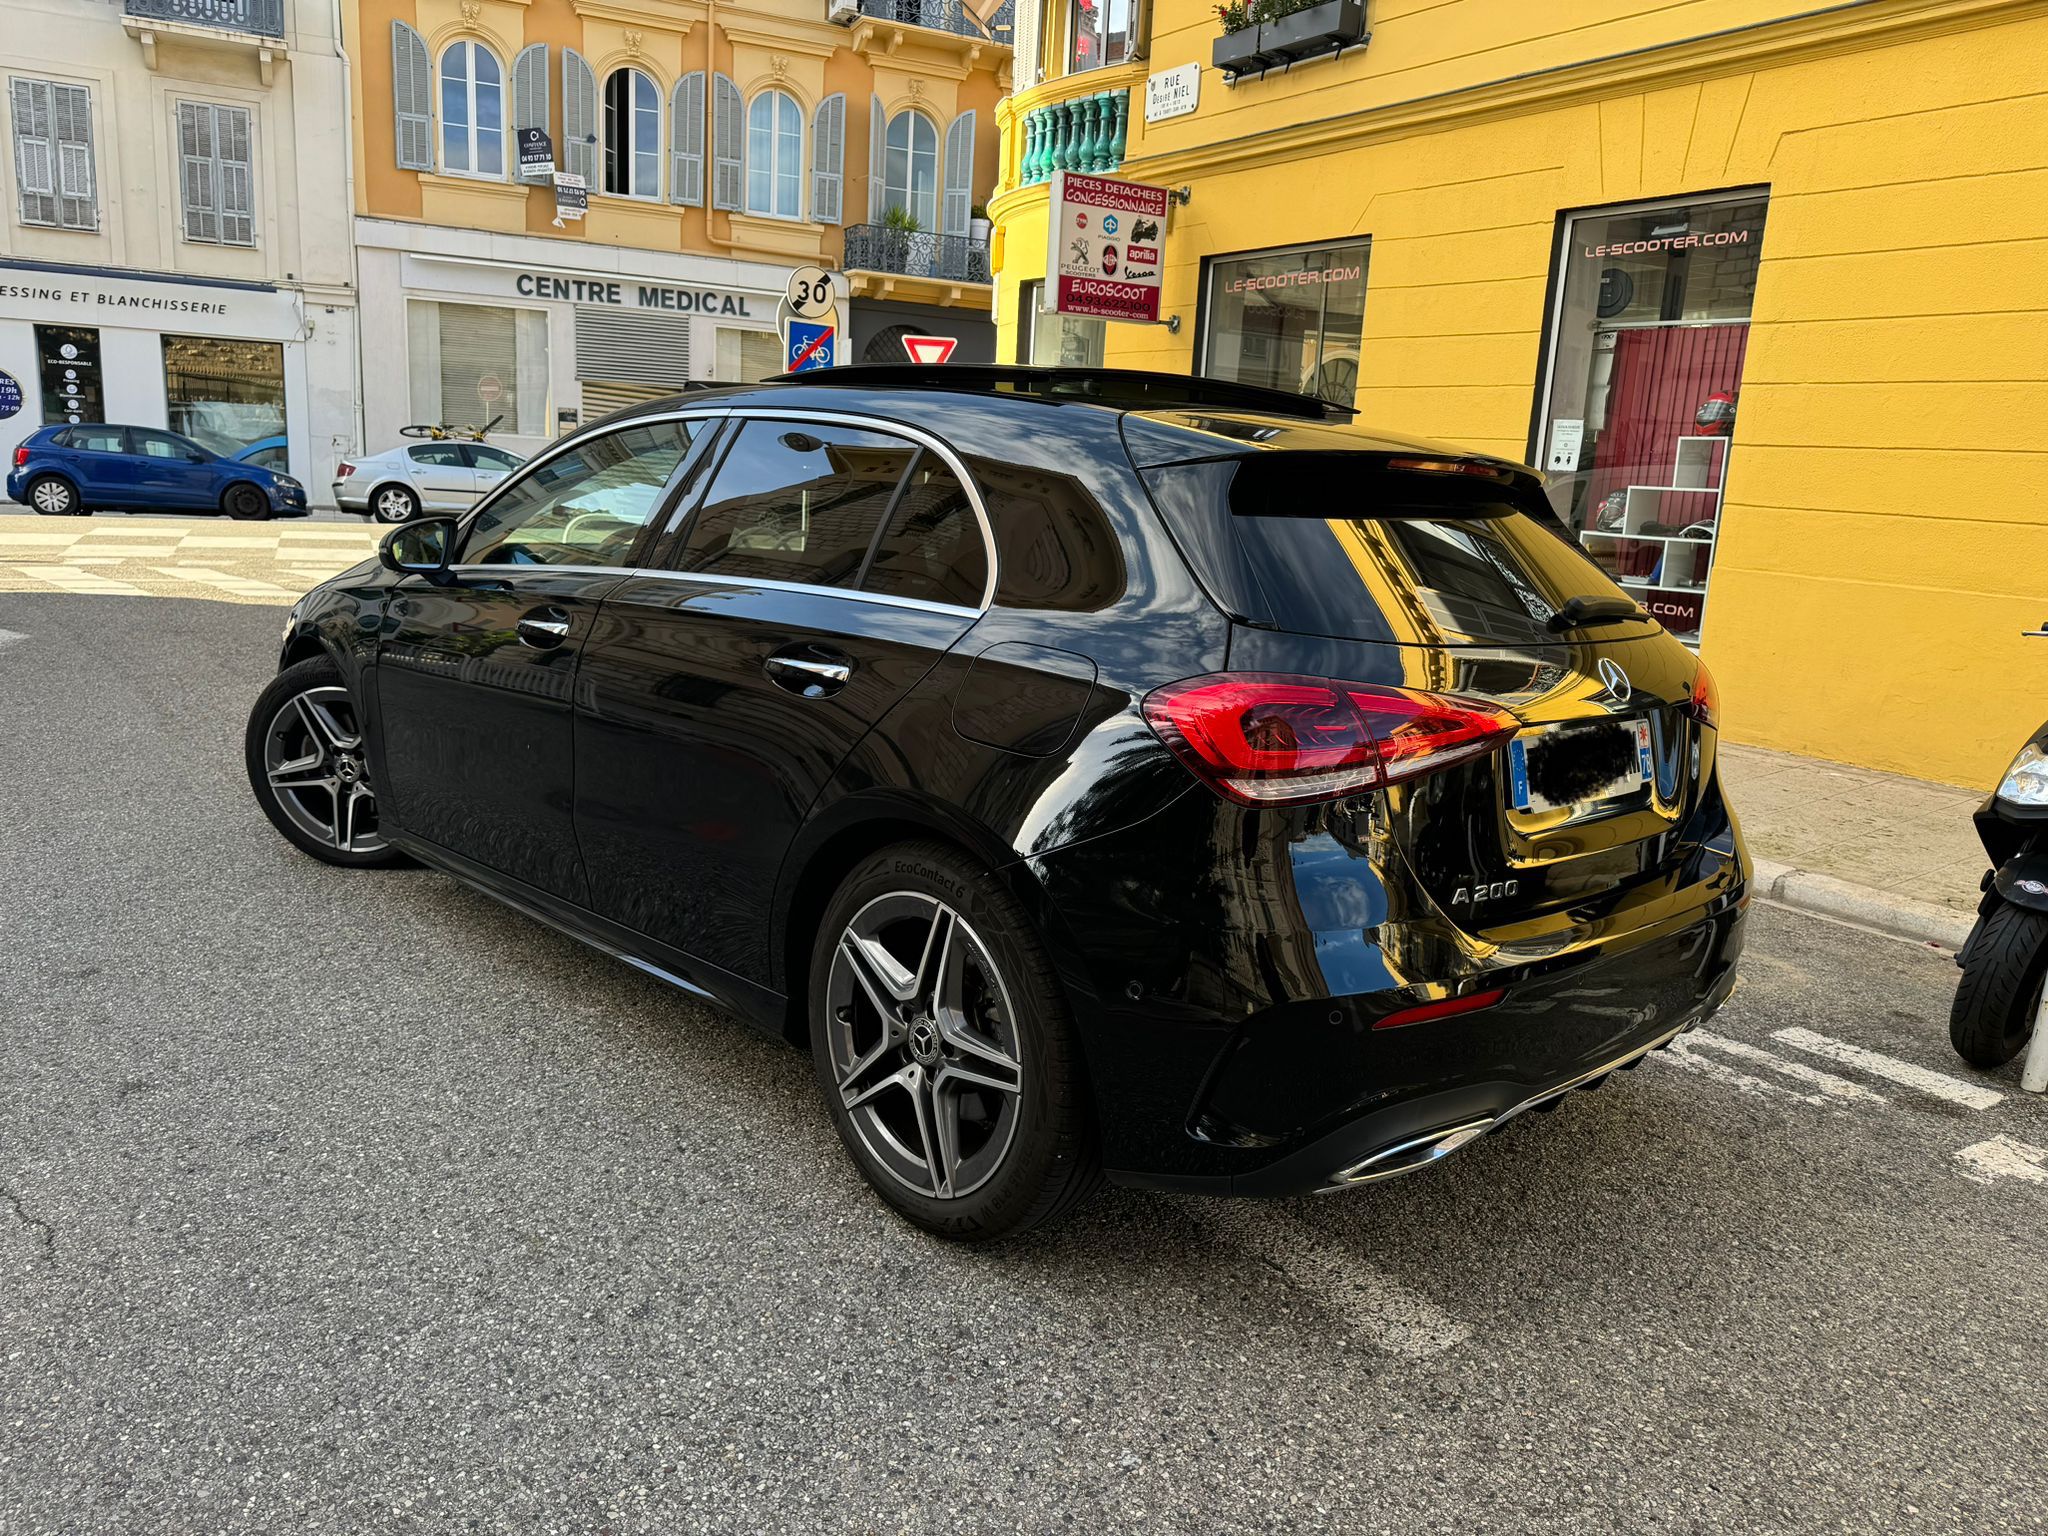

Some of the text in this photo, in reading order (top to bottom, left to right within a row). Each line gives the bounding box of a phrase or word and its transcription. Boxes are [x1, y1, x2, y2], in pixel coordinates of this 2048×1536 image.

[1164, 74, 1181, 89] RUE
[1173, 85, 1190, 100] NIEL
[1067, 176, 1163, 201] PIECES DETACHEES
[1065, 188, 1164, 215] CONCESSIONNAIRE
[1129, 248, 1155, 261] aprilia
[1584, 230, 1748, 258] LE-SCOOTER.COM
[1060, 263, 1100, 274] PEUGEOT
[1065, 270, 1096, 278] SCOOTERS
[1224, 266, 1360, 293] LE-SCOOTER.COM
[0, 285, 228, 315] ESSING ET BLANCHISSERIE
[516, 274, 751, 317] CENTRE MEDICAL
[796, 280, 827, 304] 30
[1071, 279, 1148, 300] EUROSCOOT
[47, 358, 93, 367] ECO-RESPONSABLE
[1517, 780, 1524, 795] F
[894, 860, 966, 898] EcoContact 6
[1451, 879, 1519, 905] A 200
